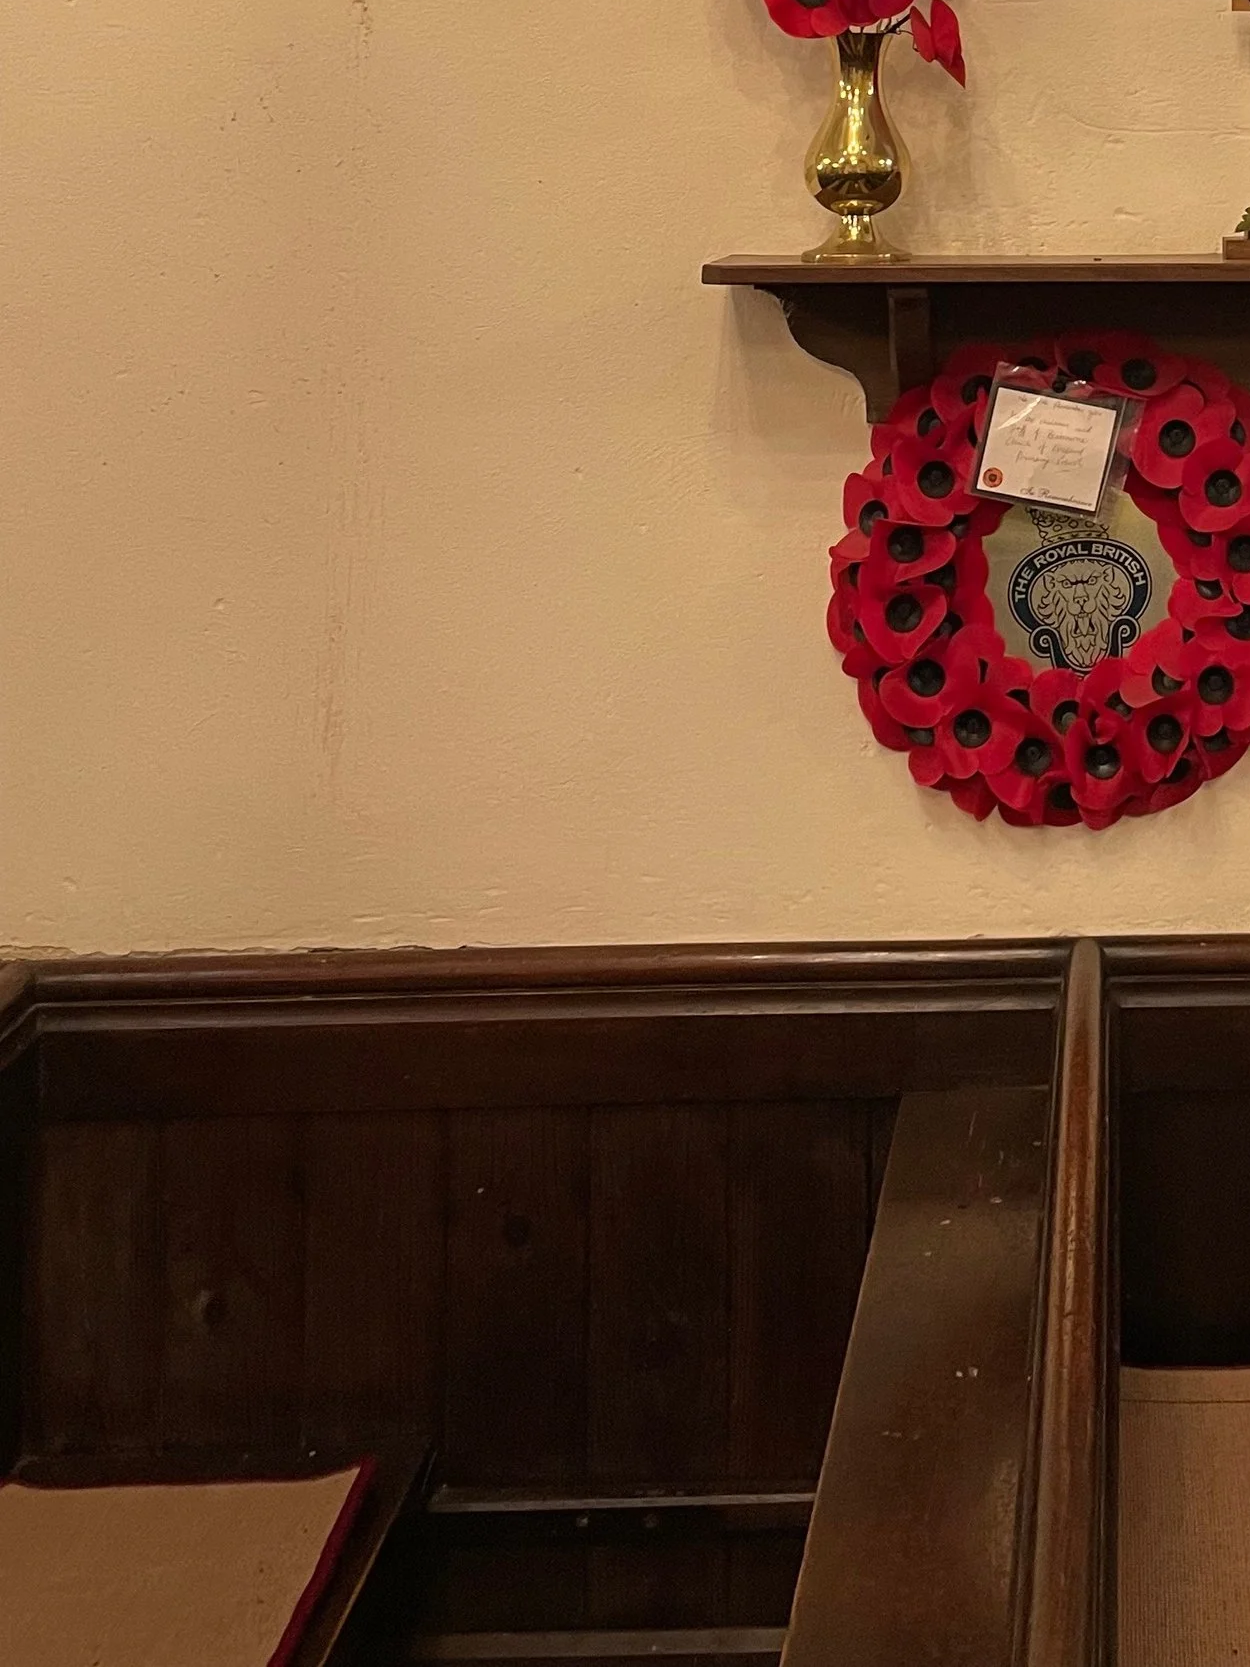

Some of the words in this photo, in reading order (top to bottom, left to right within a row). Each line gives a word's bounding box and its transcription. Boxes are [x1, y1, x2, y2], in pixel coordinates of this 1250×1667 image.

[1014, 565, 1036, 603] THE
[1033, 542, 1089, 569] ROYAL
[1090, 542, 1147, 587] BRITISH
